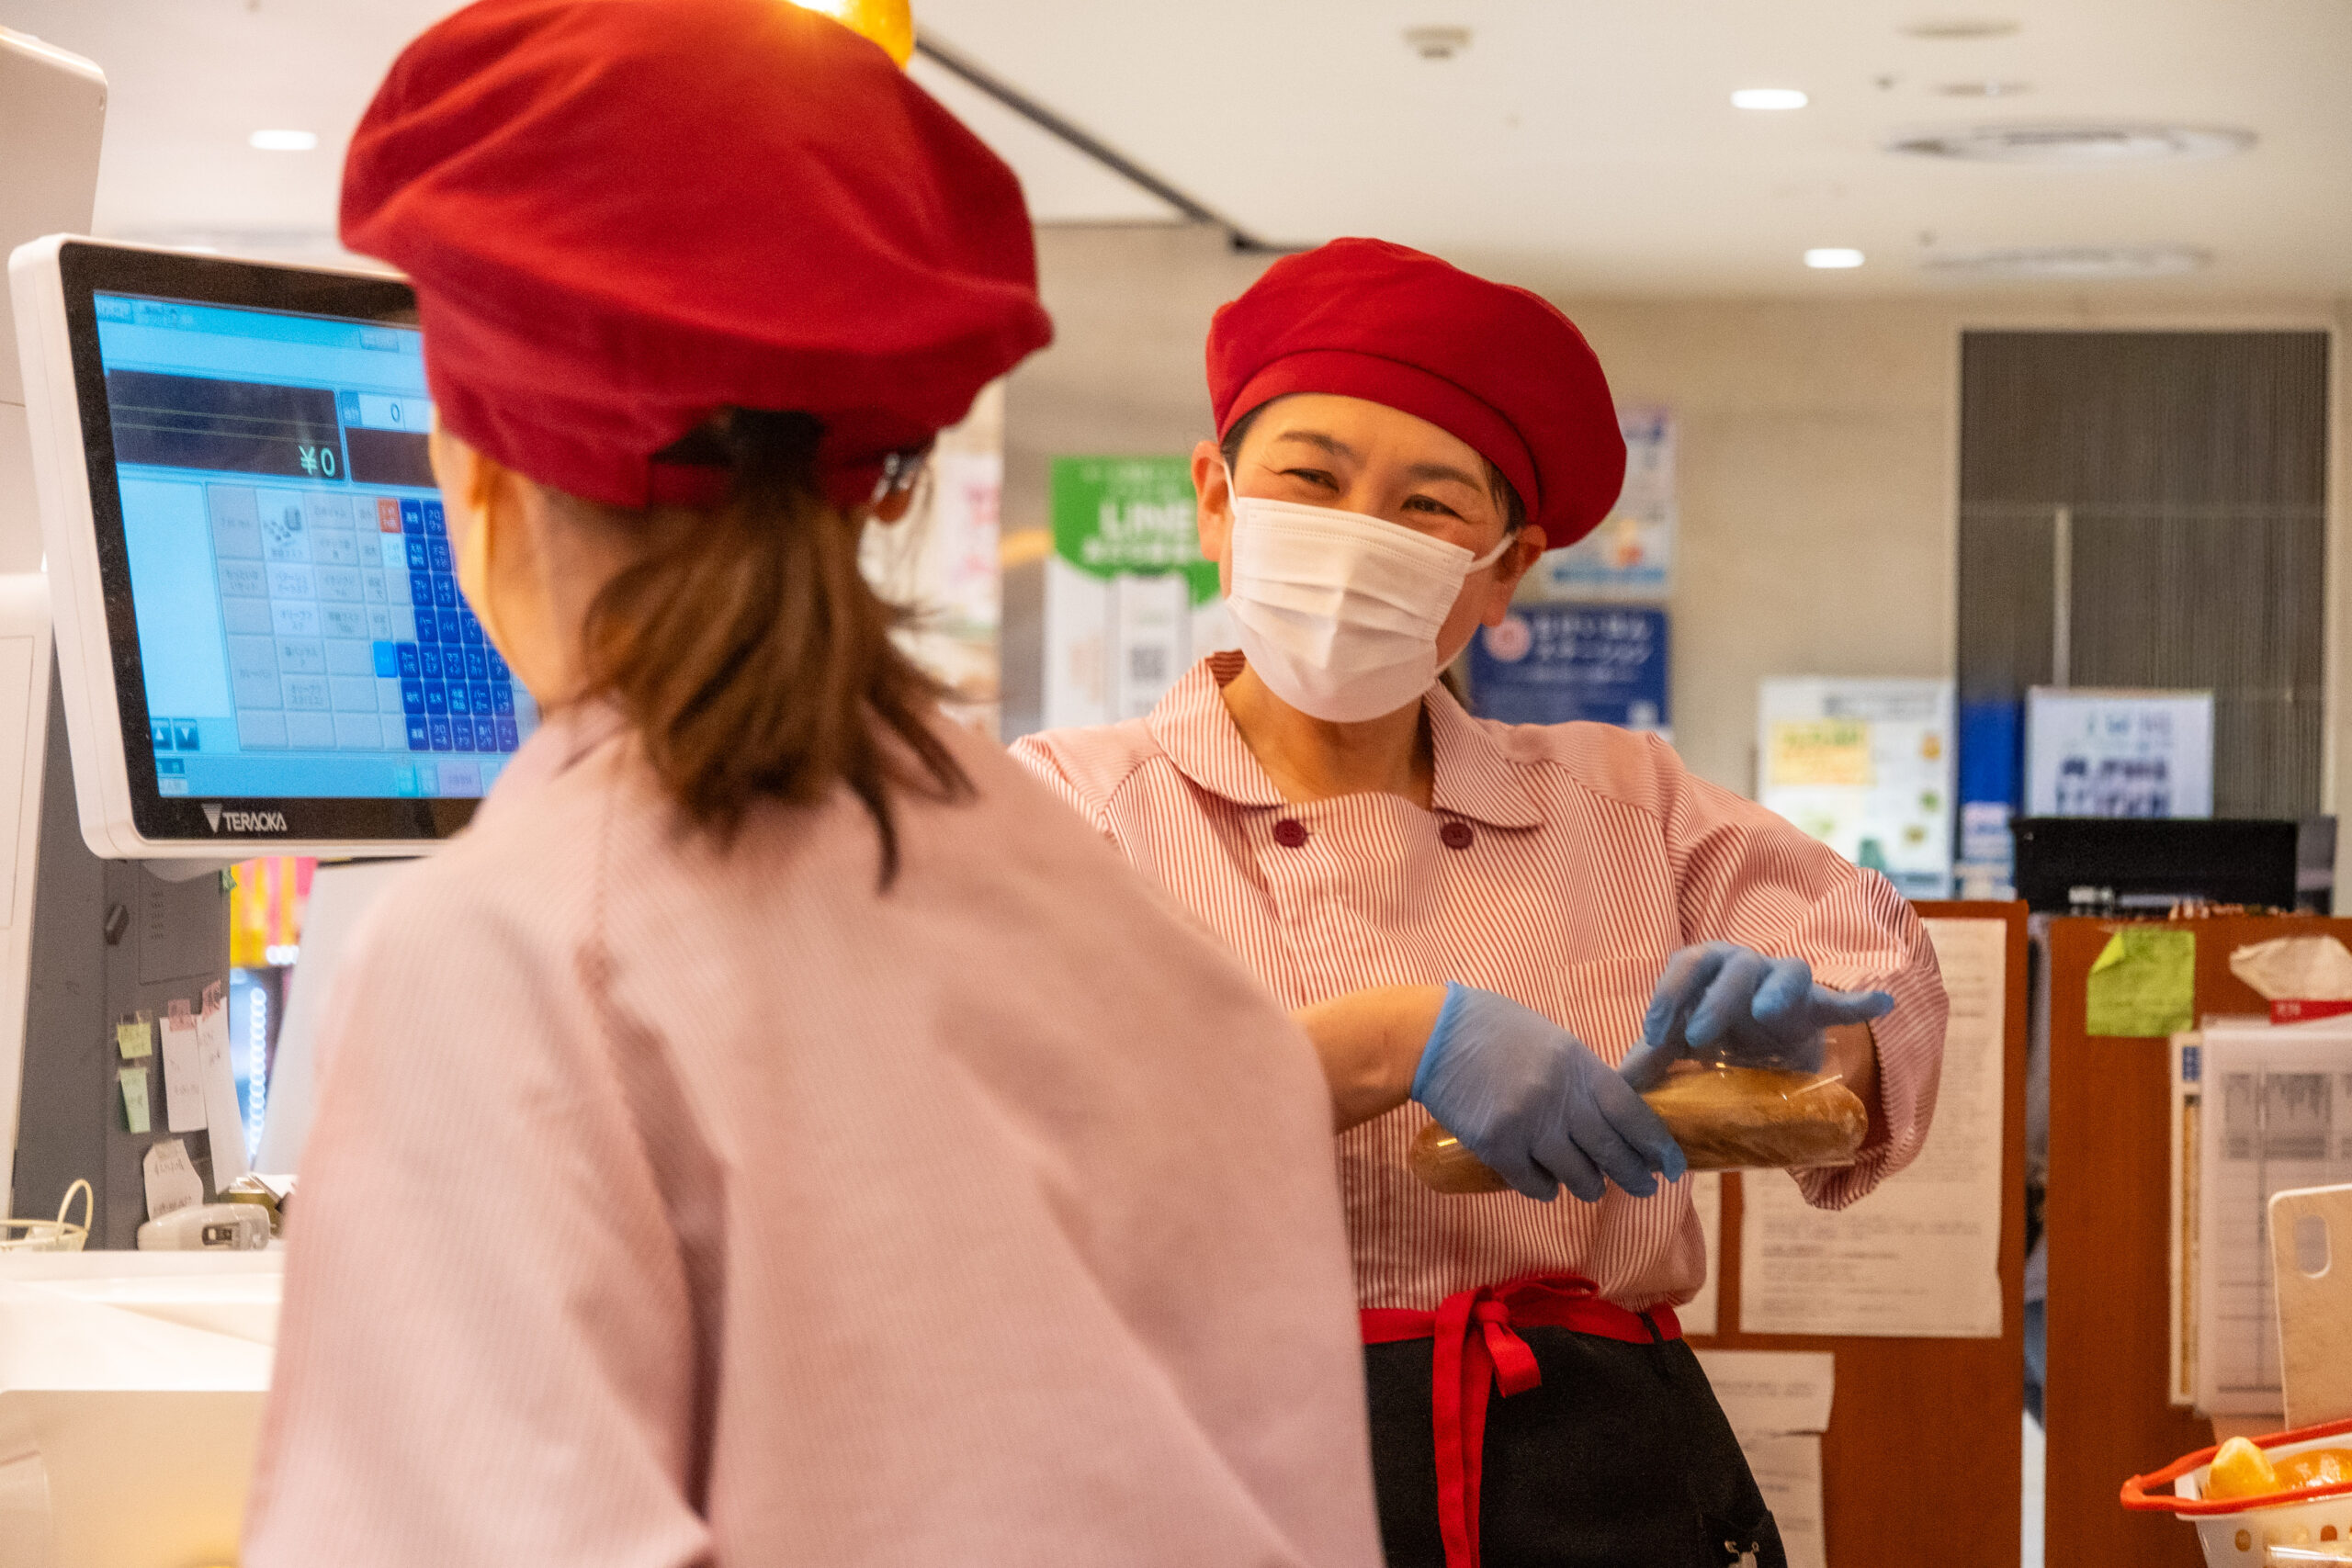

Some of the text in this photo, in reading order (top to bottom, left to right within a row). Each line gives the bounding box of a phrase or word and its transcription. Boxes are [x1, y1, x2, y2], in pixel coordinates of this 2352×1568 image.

[390, 403, 401, 423] 0
[299, 446, 335, 478] ¥0
[1100, 502, 1193, 540] LINE
[222, 812, 288, 832] TERAOKA
